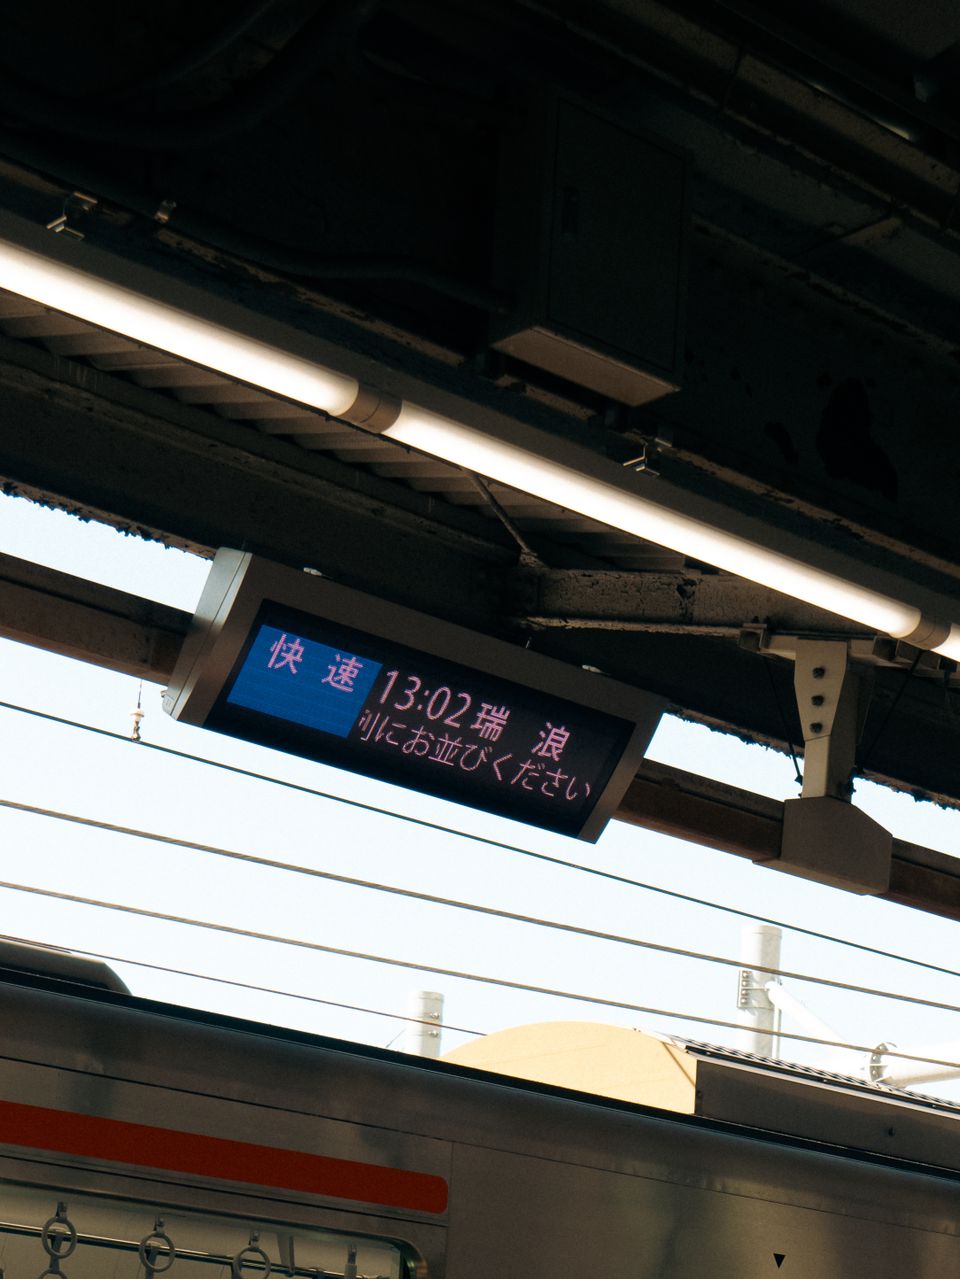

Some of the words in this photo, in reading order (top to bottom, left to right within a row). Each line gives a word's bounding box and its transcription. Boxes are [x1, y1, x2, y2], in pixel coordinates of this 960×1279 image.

[267, 632, 363, 693] 快速
[380, 669, 472, 722] 13:02
[469, 702, 571, 762] 瑞浪
